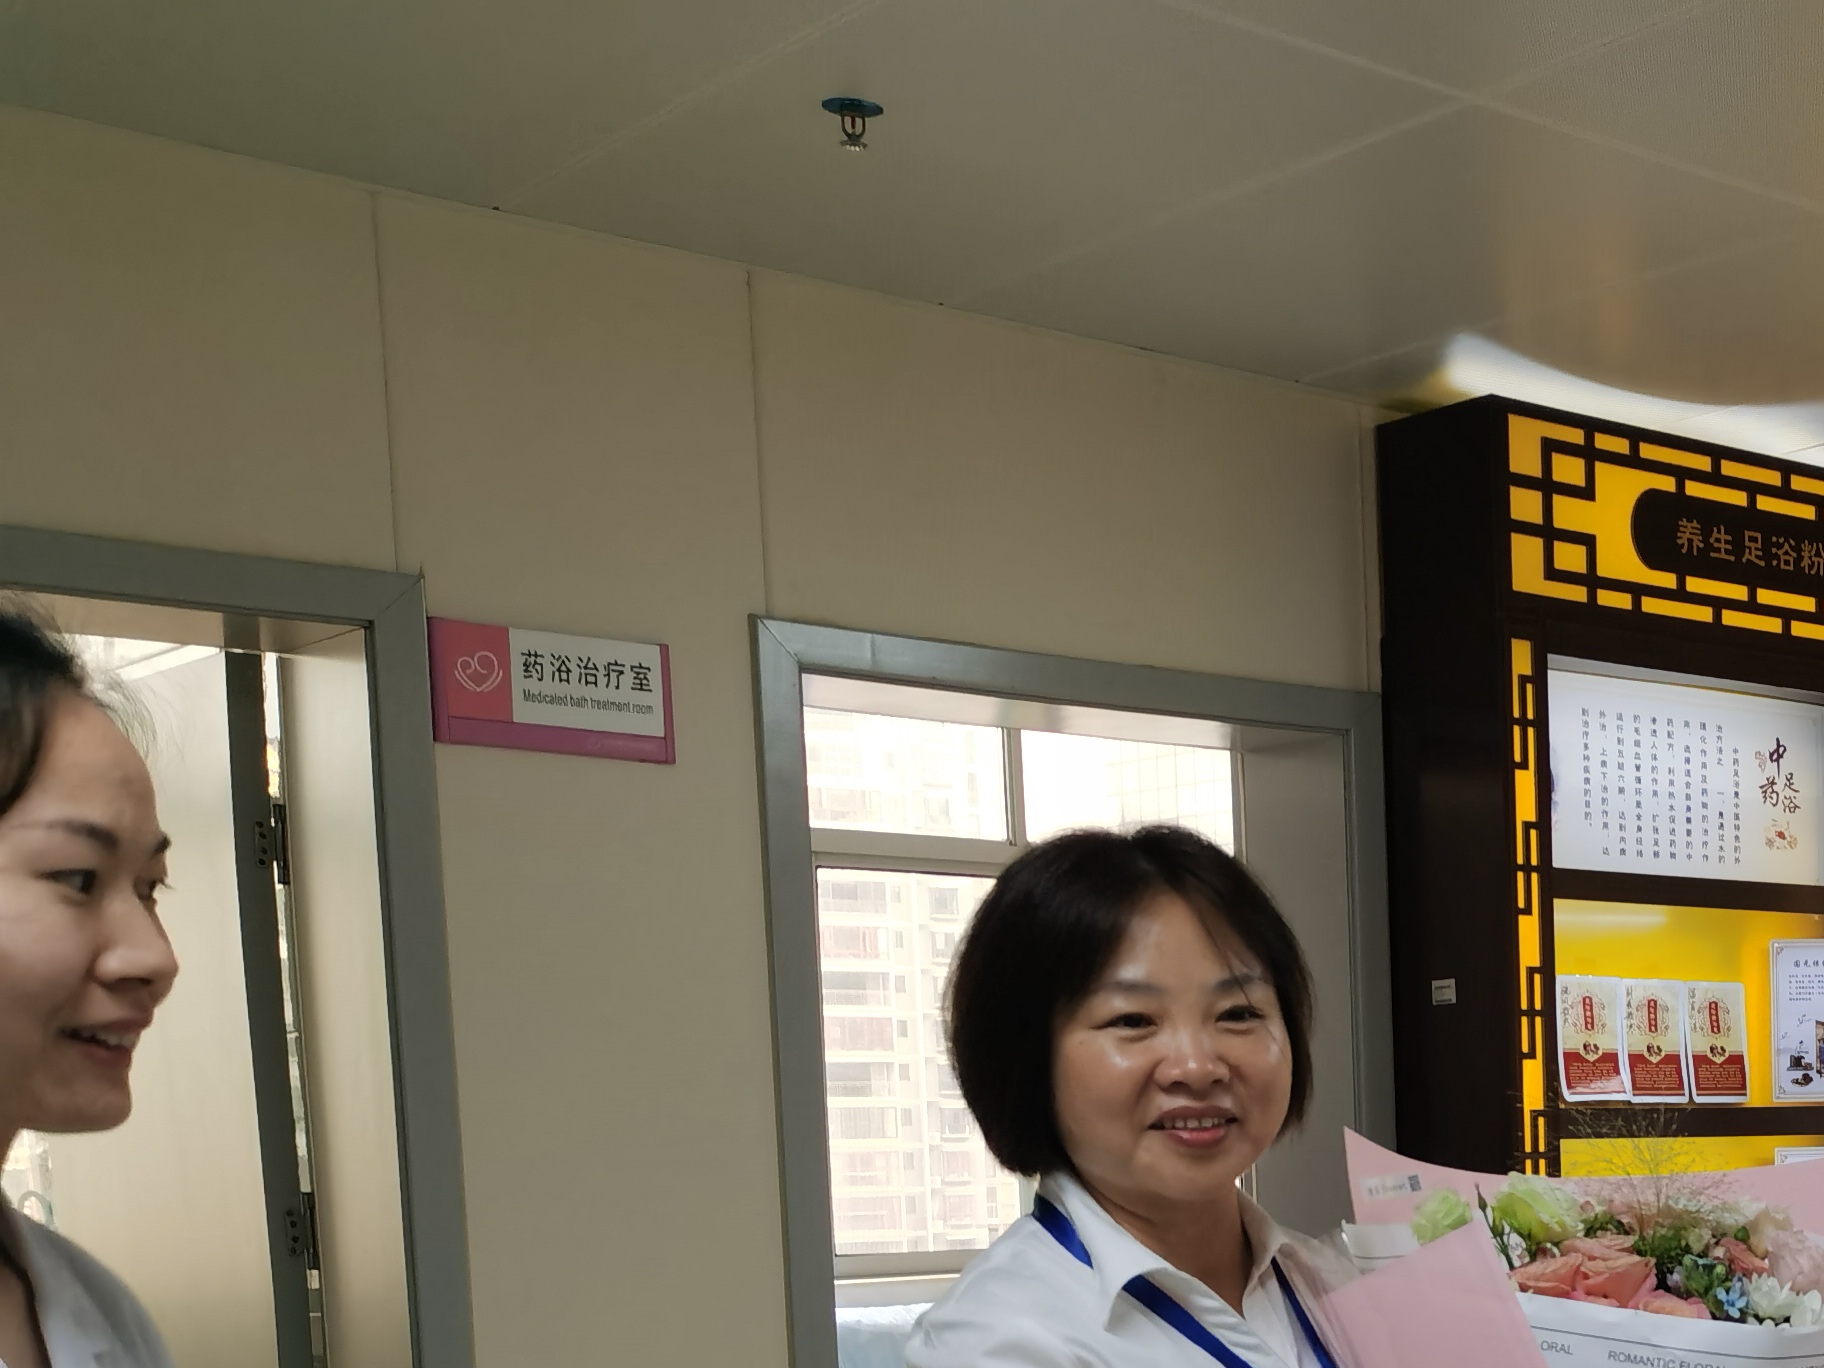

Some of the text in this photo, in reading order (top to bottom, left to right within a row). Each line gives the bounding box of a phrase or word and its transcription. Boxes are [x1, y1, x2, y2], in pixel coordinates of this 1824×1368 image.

[521, 649, 653, 692] 药浴治疗室
[570, 693, 588, 709] bath
[1541, 1340, 1573, 1356] ORAL
